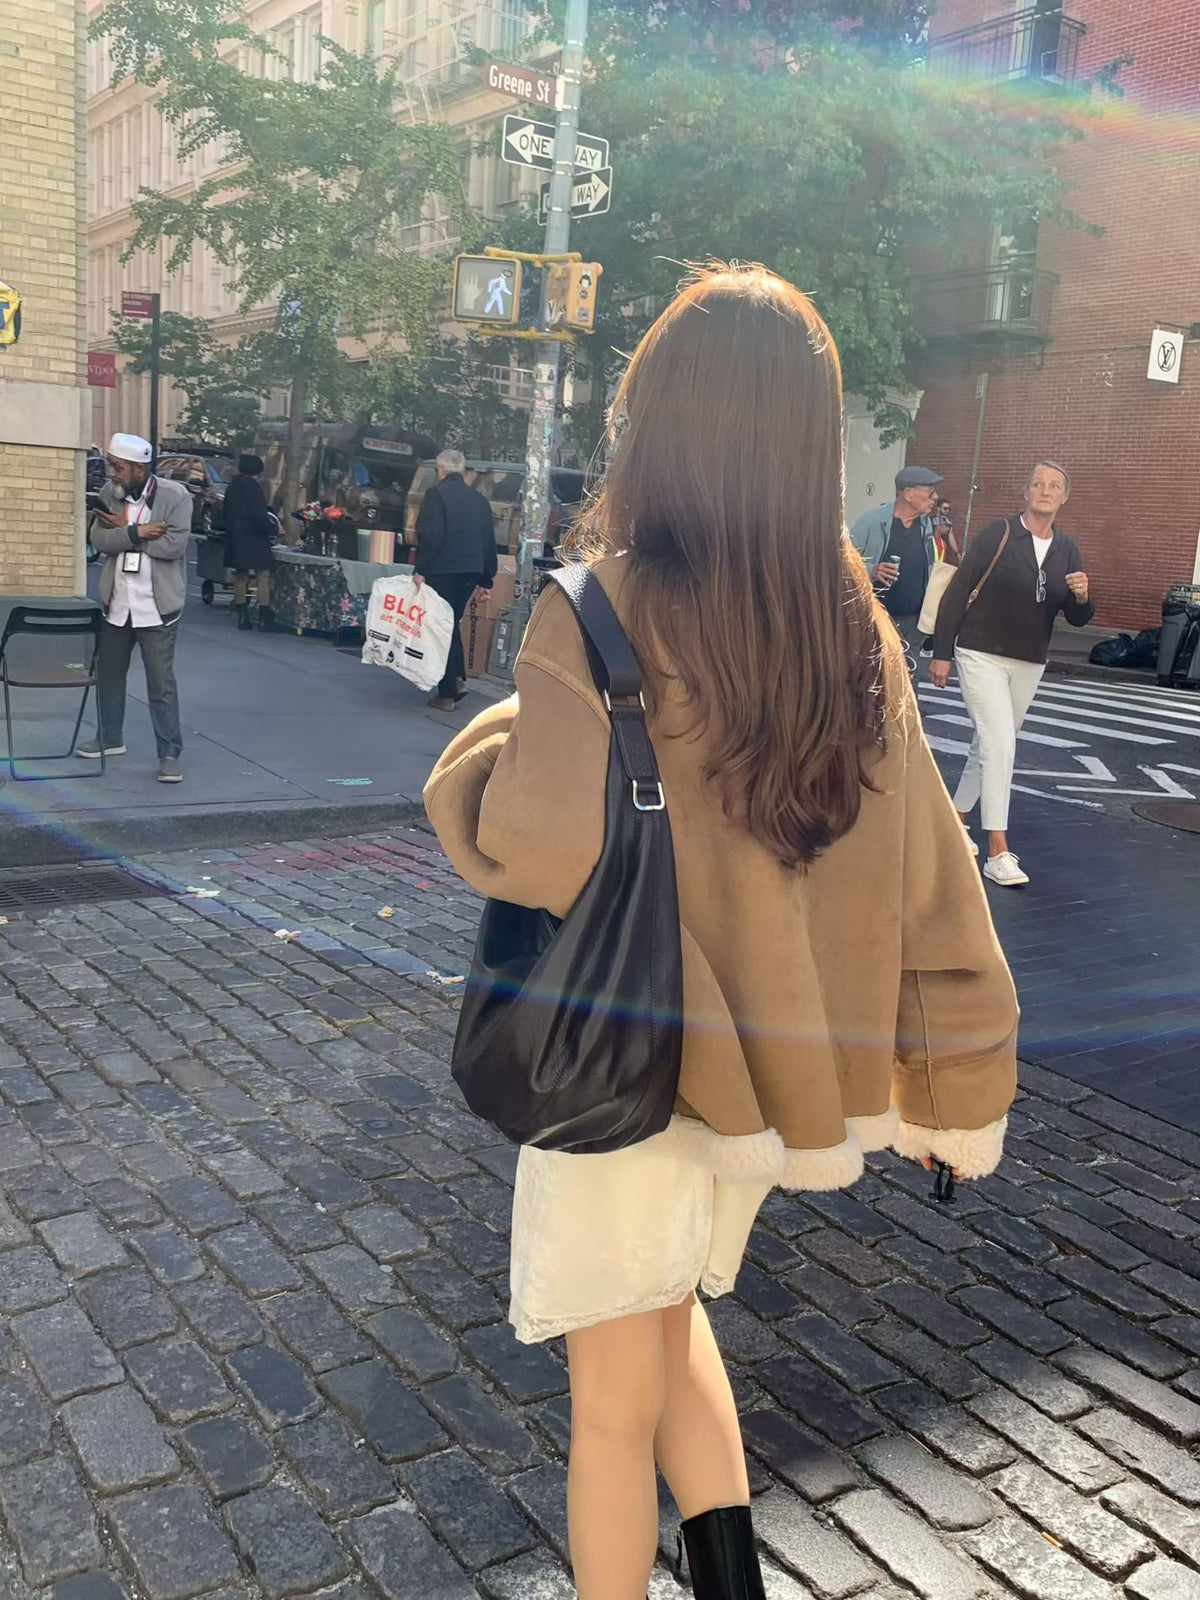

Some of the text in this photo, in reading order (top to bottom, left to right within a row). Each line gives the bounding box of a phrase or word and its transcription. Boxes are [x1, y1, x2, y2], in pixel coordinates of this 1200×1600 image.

[489, 65, 550, 103] Greene St
[519, 134, 550, 156] ONE
[577, 183, 600, 203] WAY
[383, 594, 426, 626] BLCK
